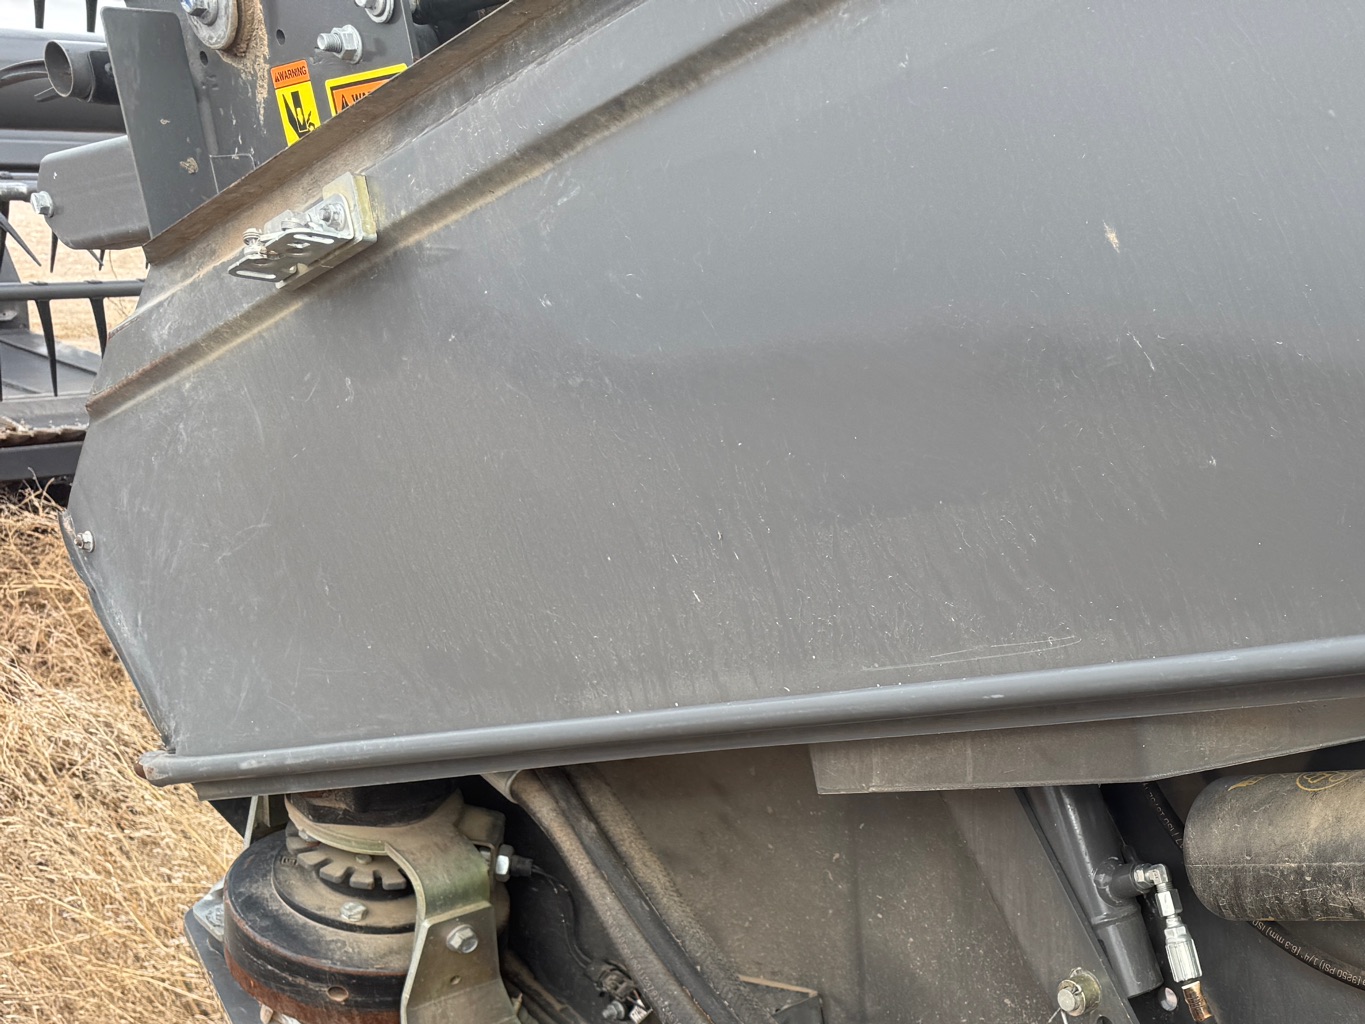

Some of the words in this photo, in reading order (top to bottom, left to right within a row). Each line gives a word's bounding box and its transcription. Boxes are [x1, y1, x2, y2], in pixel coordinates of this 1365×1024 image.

[279, 66, 307, 80] WARNING
[1252, 920, 1266, 931] ISO
[1265, 926, 1285, 944] mm)
[1284, 940, 1302, 956] (6.3
[1319, 959, 1336, 975] PSI)
[1336, 969, 1362, 986] (3250
